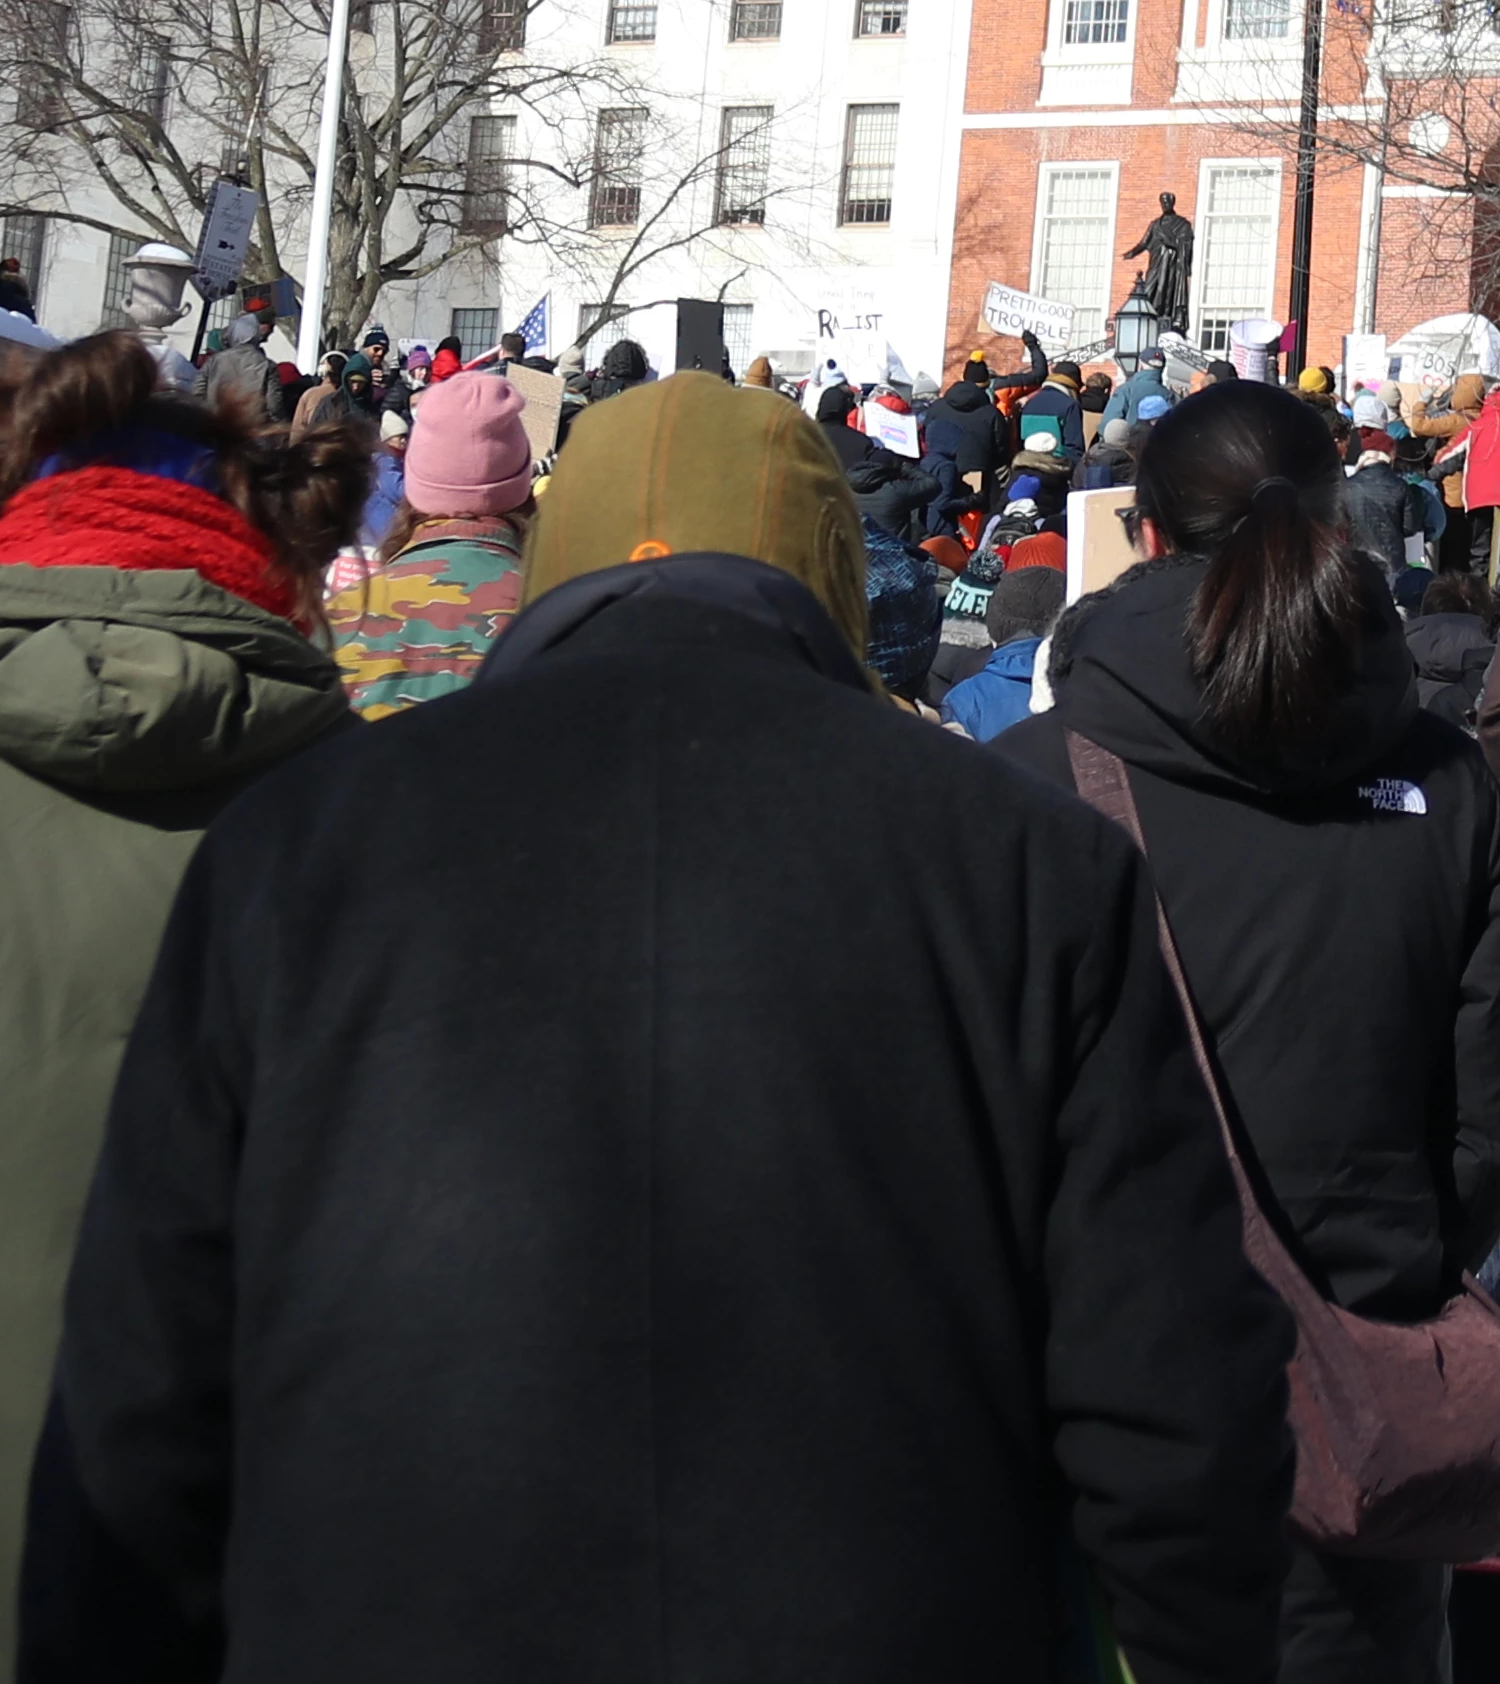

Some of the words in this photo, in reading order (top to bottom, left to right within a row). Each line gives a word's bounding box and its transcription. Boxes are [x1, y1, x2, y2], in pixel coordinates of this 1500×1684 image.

[990, 286, 1036, 313] PRETTI
[1038, 302, 1075, 320] GOOD
[988, 307, 1068, 340] TROUBLE
[1377, 778, 1403, 790] THE
[1358, 786, 1404, 800] NORTH
[1372, 798, 1405, 811] FACE
